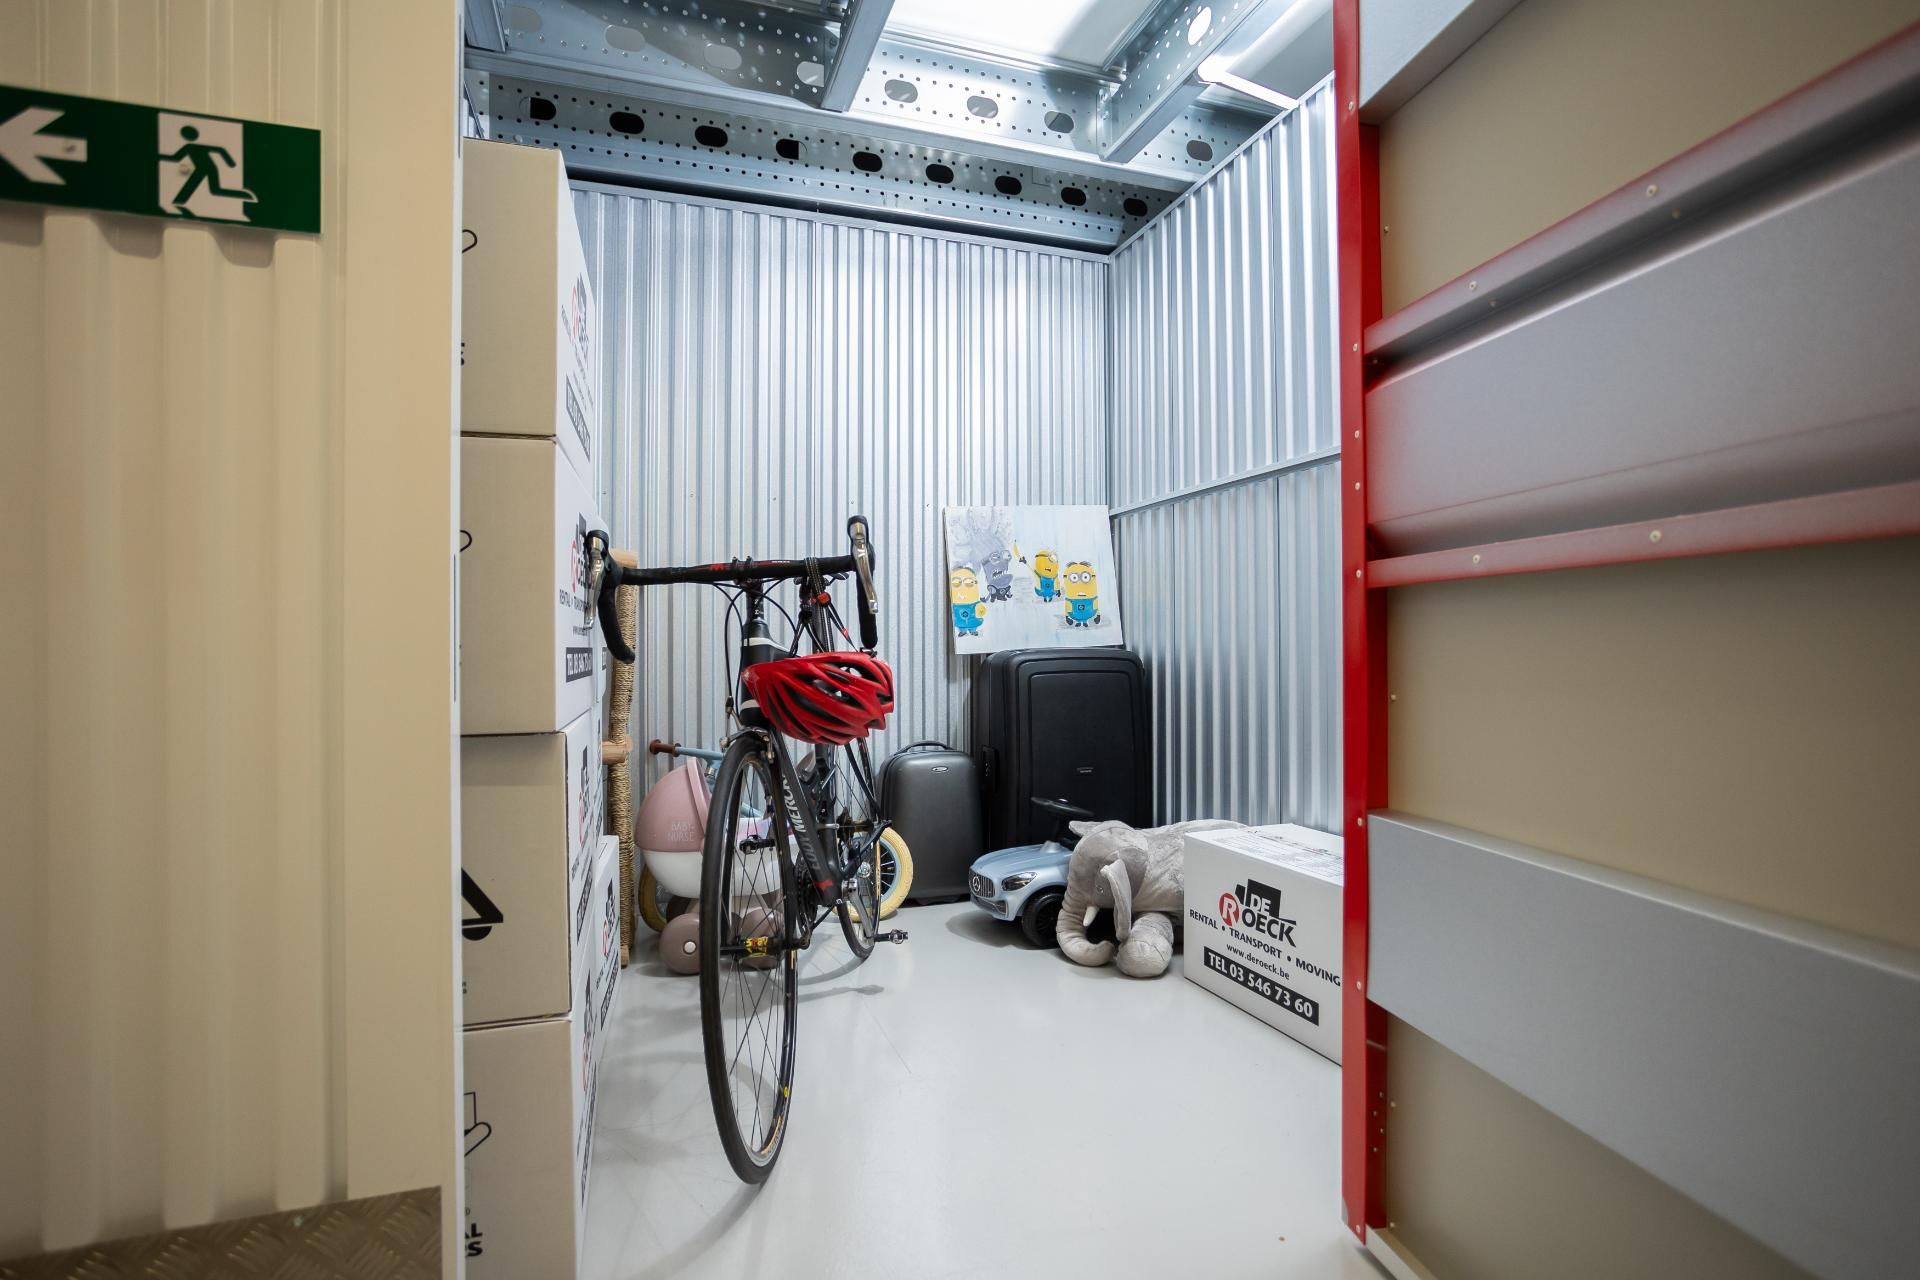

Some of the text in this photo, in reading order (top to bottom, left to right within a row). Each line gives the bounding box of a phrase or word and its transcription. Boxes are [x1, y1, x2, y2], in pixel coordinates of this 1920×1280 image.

[781, 774, 806, 833] MERCK
[1219, 893, 1297, 948] ROECK
[1249, 893, 1272, 913] DE
[1189, 908, 1341, 987] RENTAL TRANSPORT MOVING
[1226, 943, 1290, 980] www.deroeck.be
[1208, 951, 1313, 1018] TEL 03 546 73 60
